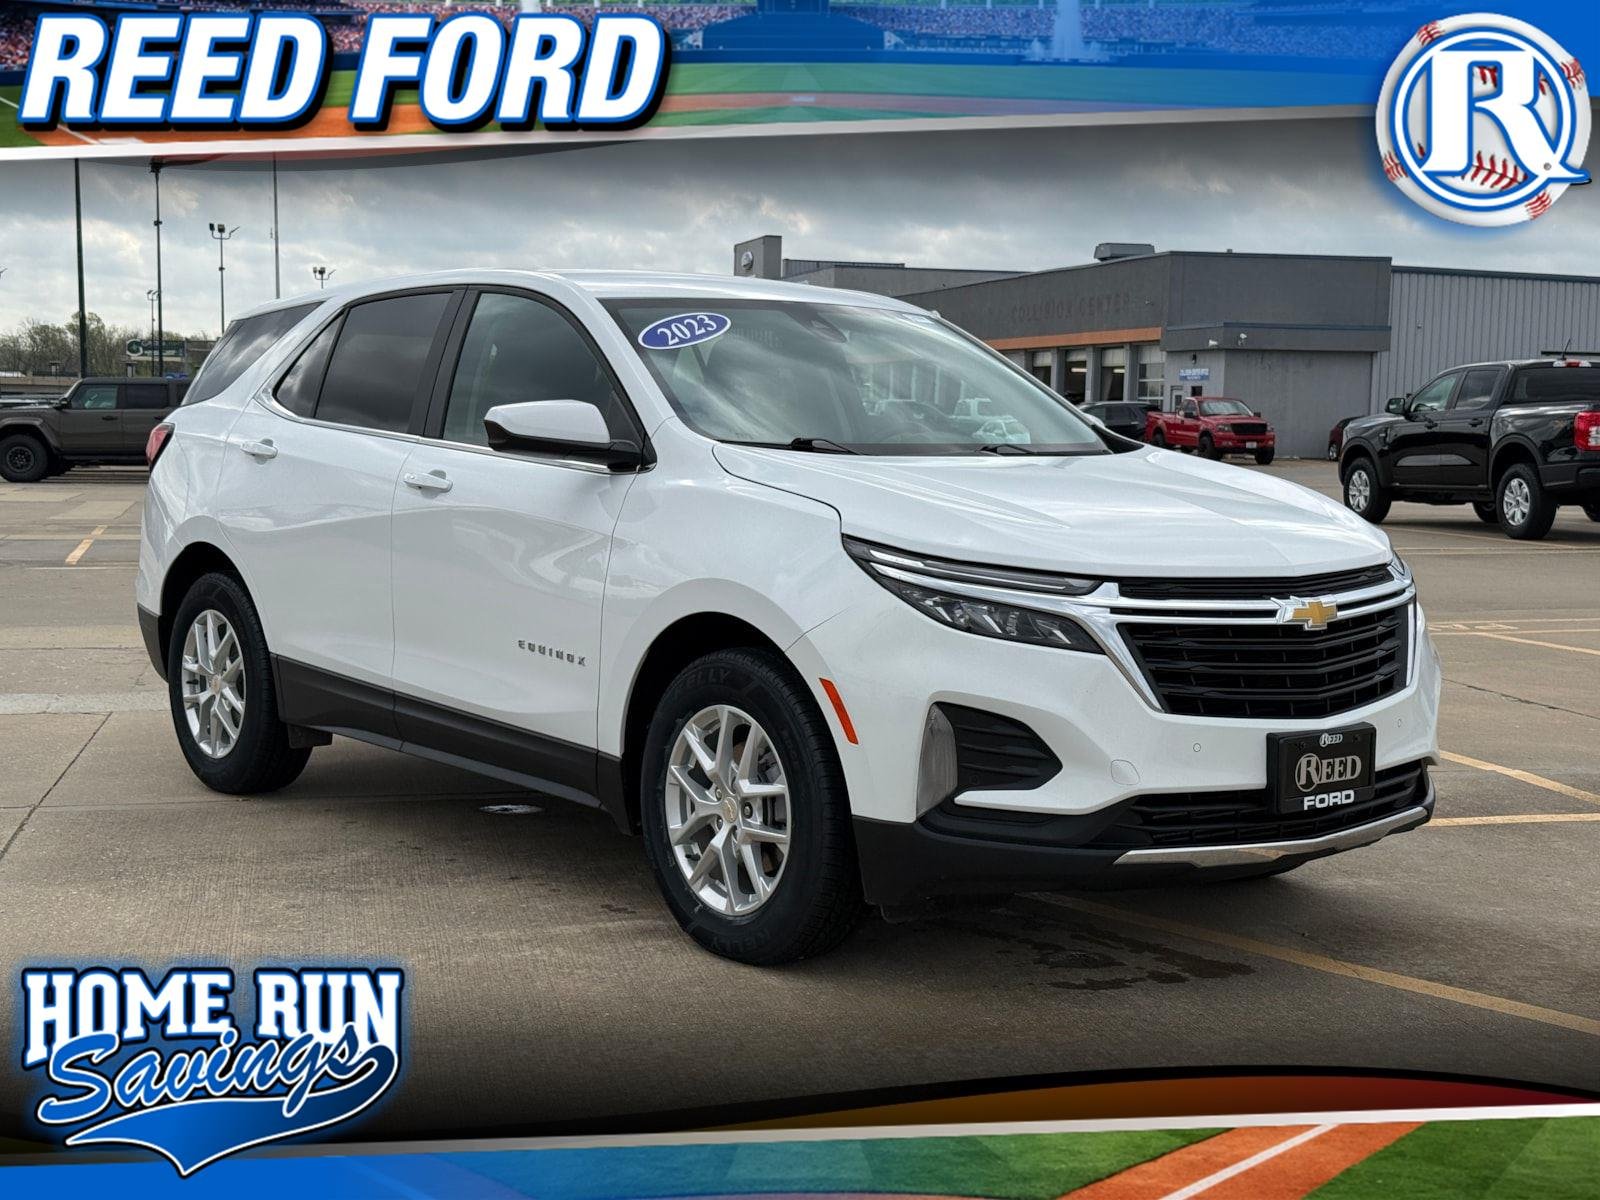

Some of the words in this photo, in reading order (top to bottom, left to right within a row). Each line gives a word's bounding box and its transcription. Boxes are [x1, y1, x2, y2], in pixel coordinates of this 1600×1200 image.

[657, 314, 717, 346] 2023
[517, 639, 586, 667] EQUINOX
[1295, 753, 1361, 792] REED
[1303, 789, 1355, 811] FORD
